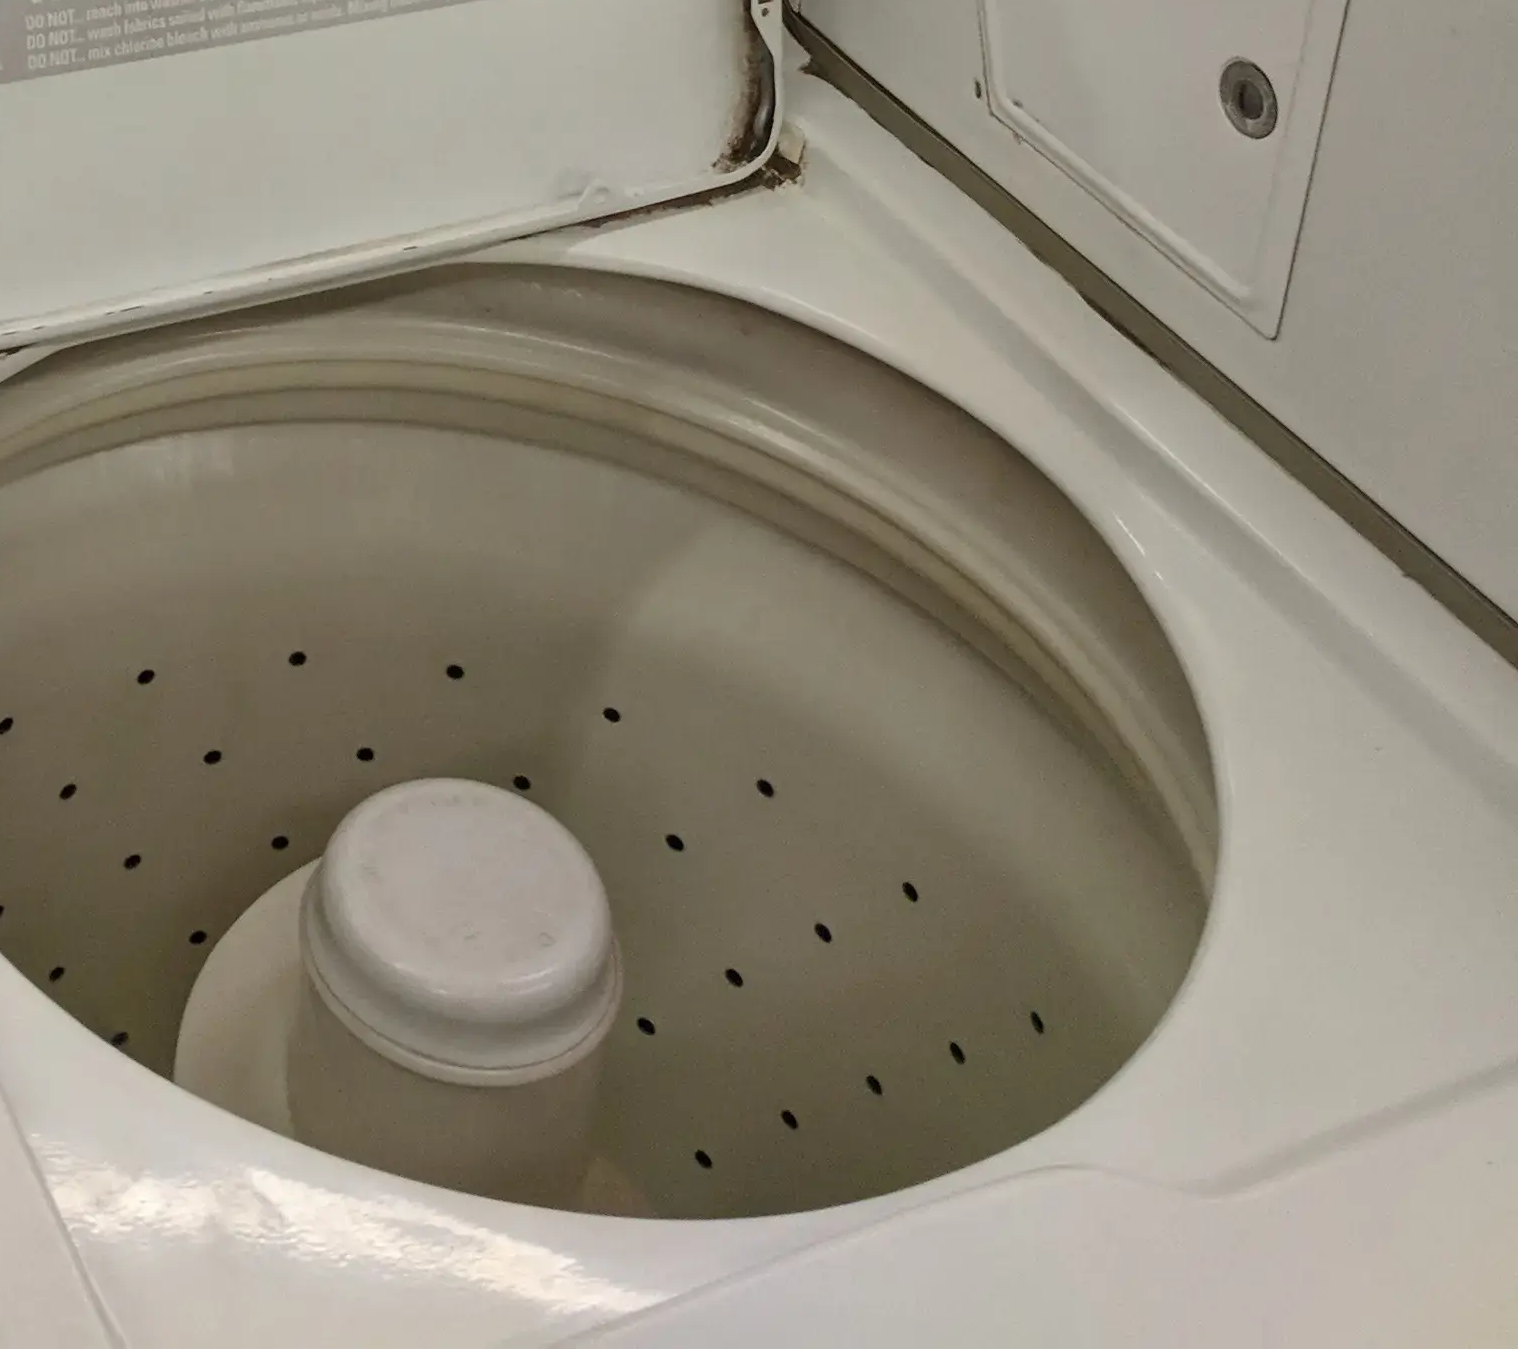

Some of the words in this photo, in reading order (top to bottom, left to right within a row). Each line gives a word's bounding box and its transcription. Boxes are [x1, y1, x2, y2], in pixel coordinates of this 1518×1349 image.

[86, 3, 123, 21] reach
[124, 0, 148, 15] into
[26, 34, 46, 51] DO
[27, 53, 46, 70] DO
[88, 43, 112, 61] mix
